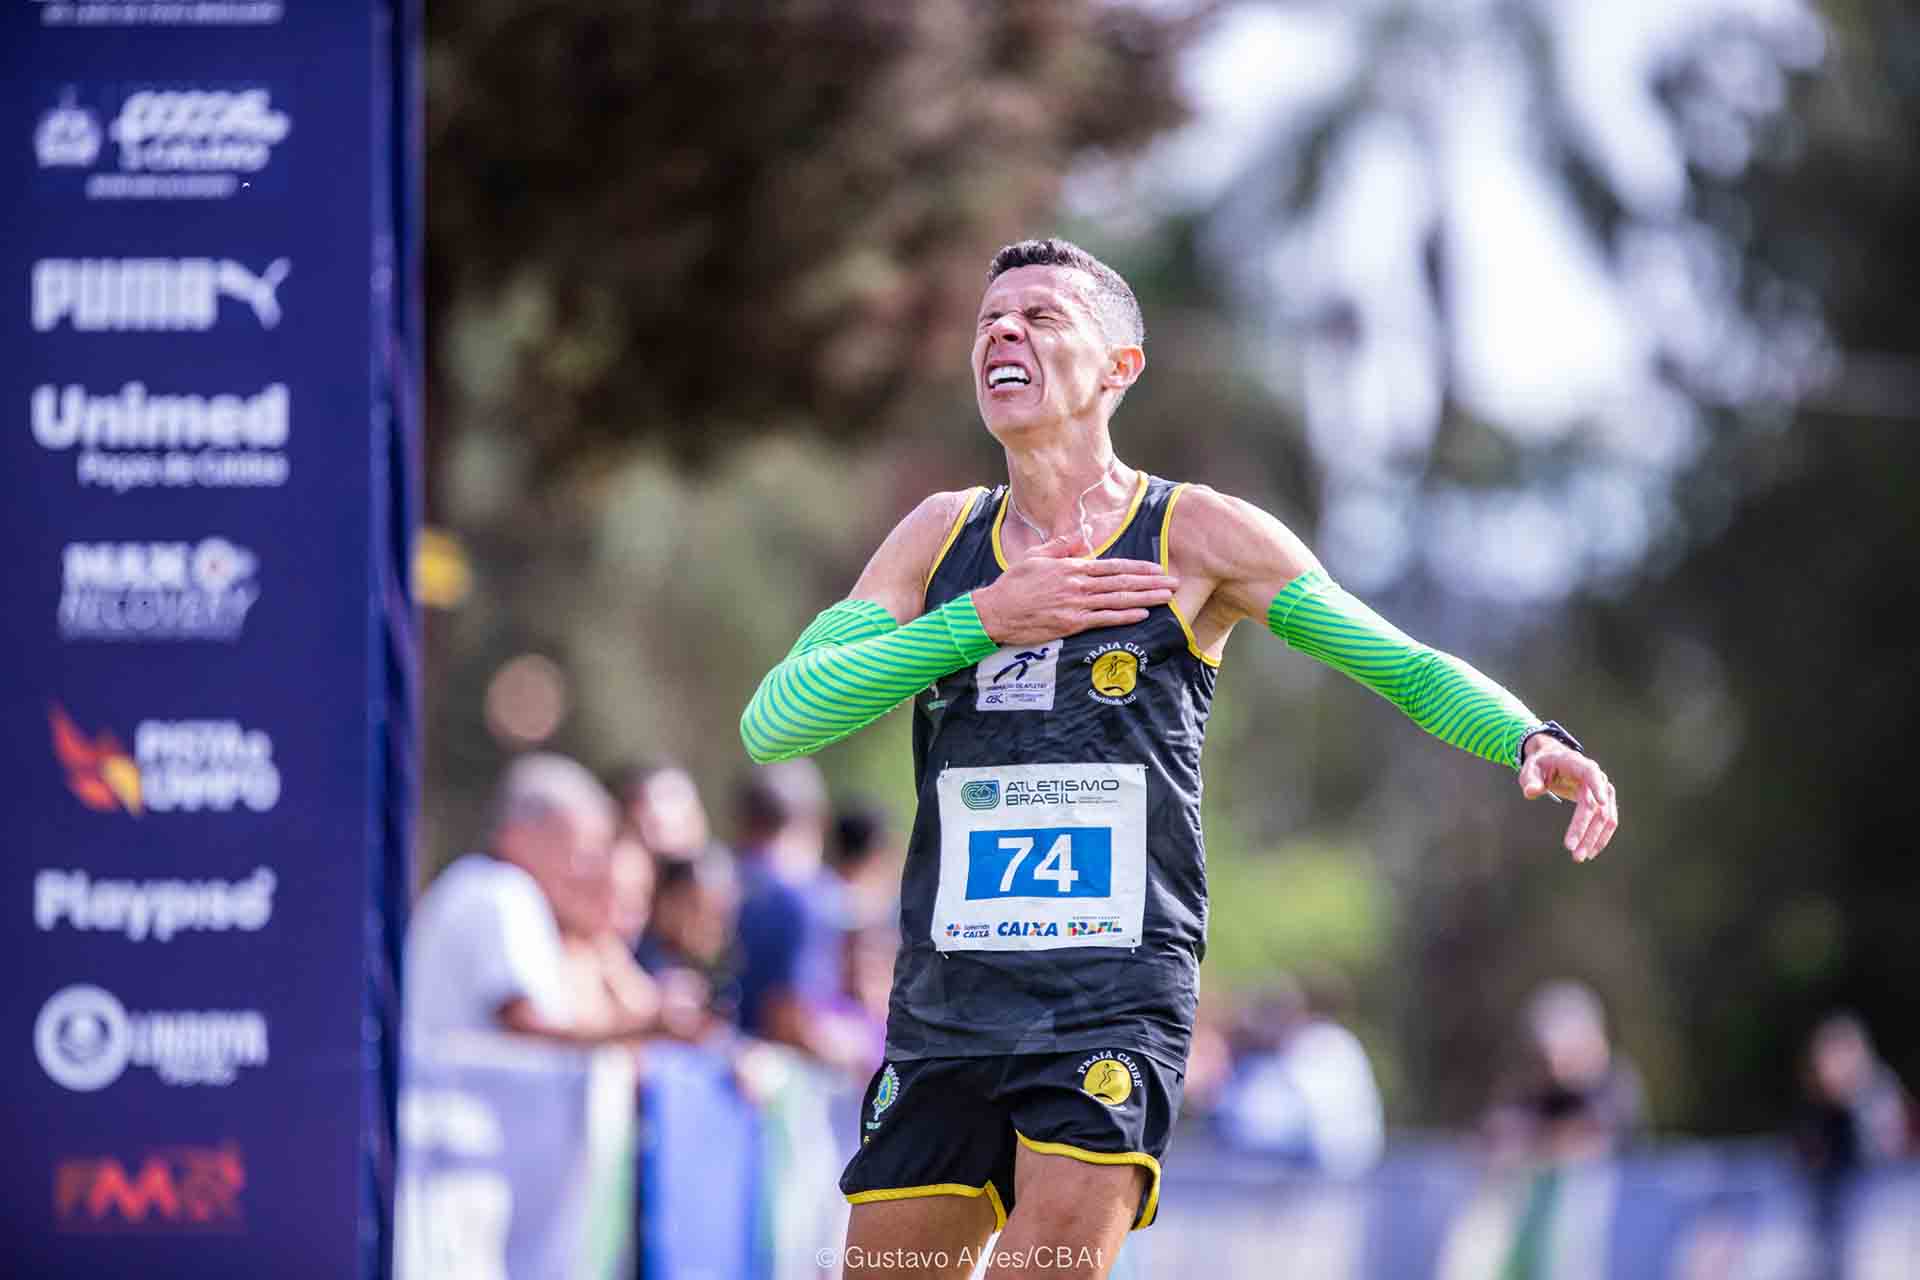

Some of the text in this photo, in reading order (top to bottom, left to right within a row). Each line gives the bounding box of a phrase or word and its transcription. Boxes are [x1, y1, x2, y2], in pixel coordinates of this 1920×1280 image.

[32, 381, 291, 450] Unimed
[1083, 641, 1121, 664] PRAIA
[1006, 779, 1120, 793] ATLETISMO
[1006, 792, 1077, 806] BRASIL
[997, 833, 1079, 893] 74
[997, 921, 1059, 937] CAIXA
[1077, 1050, 1144, 1087] PRAIA CLUBE
